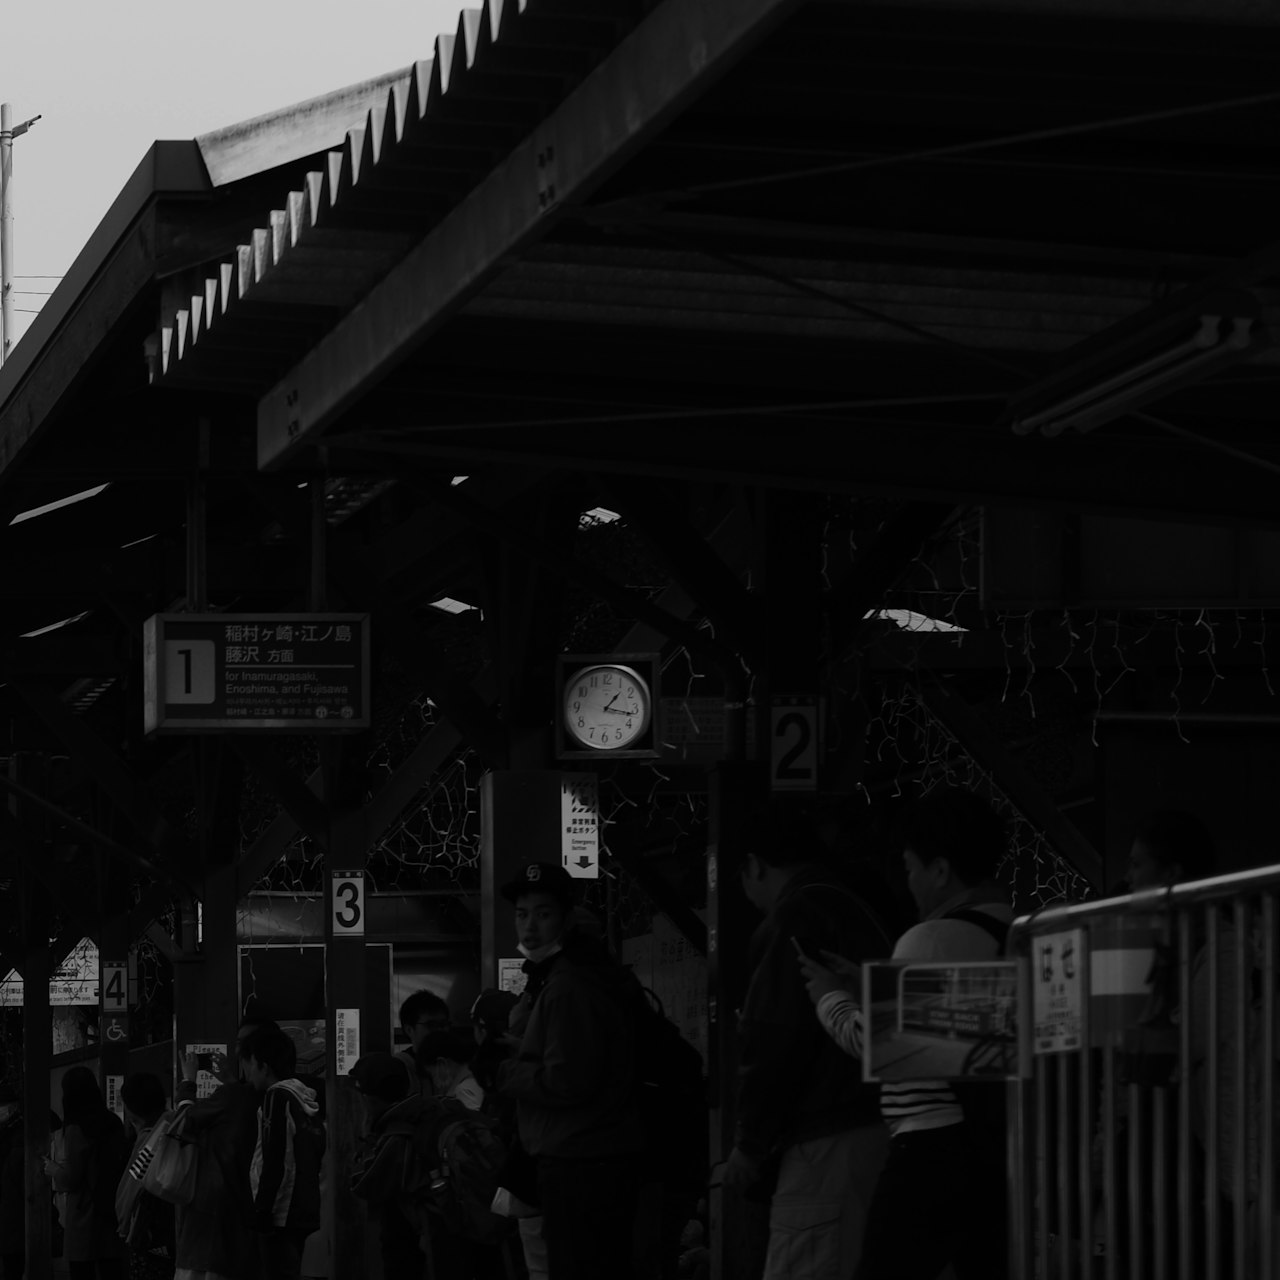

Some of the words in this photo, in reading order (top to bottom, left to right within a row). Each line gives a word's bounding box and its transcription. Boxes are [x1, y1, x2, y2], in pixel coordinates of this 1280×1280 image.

[177, 649, 192, 694] 1
[225, 646, 260, 663] 藤沢
[267, 649, 294, 663] 方面
[225, 671, 239, 681] for
[225, 684, 279, 695] Enoshima,
[281, 684, 302, 694] and
[304, 684, 349, 695] Fujisawa
[775, 712, 812, 780] 2
[335, 881, 361, 928] 3
[105, 970, 125, 1006] 4
